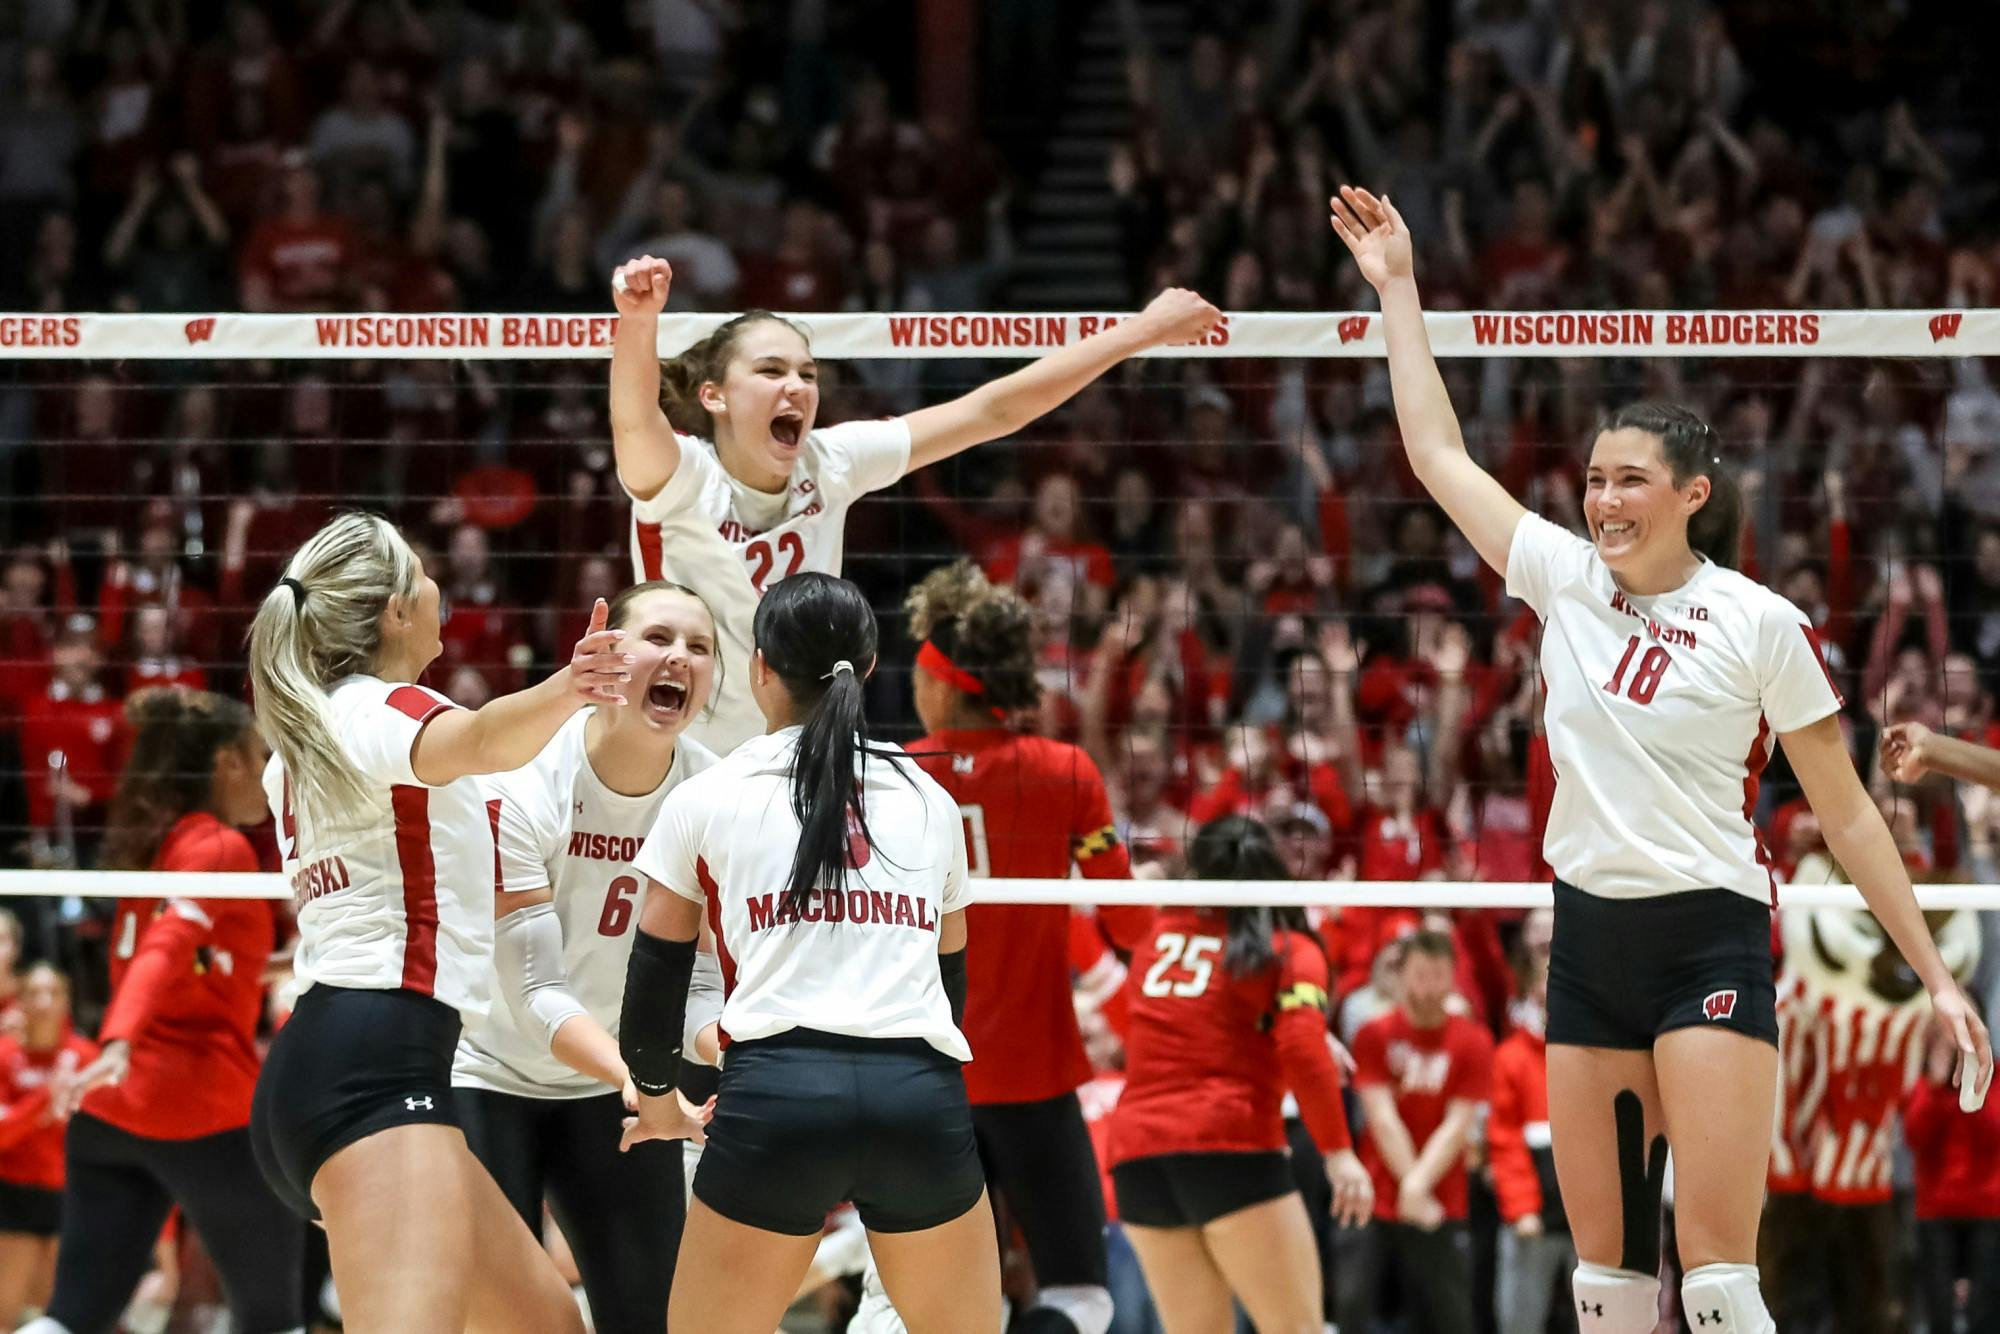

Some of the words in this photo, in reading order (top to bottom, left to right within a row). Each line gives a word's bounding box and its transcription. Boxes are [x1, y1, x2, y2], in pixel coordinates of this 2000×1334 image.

[316, 317, 489, 347] WISCONSIN
[503, 317, 619, 347] BADGE
[889, 316, 1067, 347] WISCONSIN
[1472, 315, 1653, 345] WISCONSIN
[1666, 314, 1820, 344] BADGERS
[746, 531, 805, 596] 22
[1602, 634, 1672, 705] 18
[597, 875, 638, 937] 6
[1142, 932, 1222, 998] 25
[1702, 989, 1737, 1020] W
